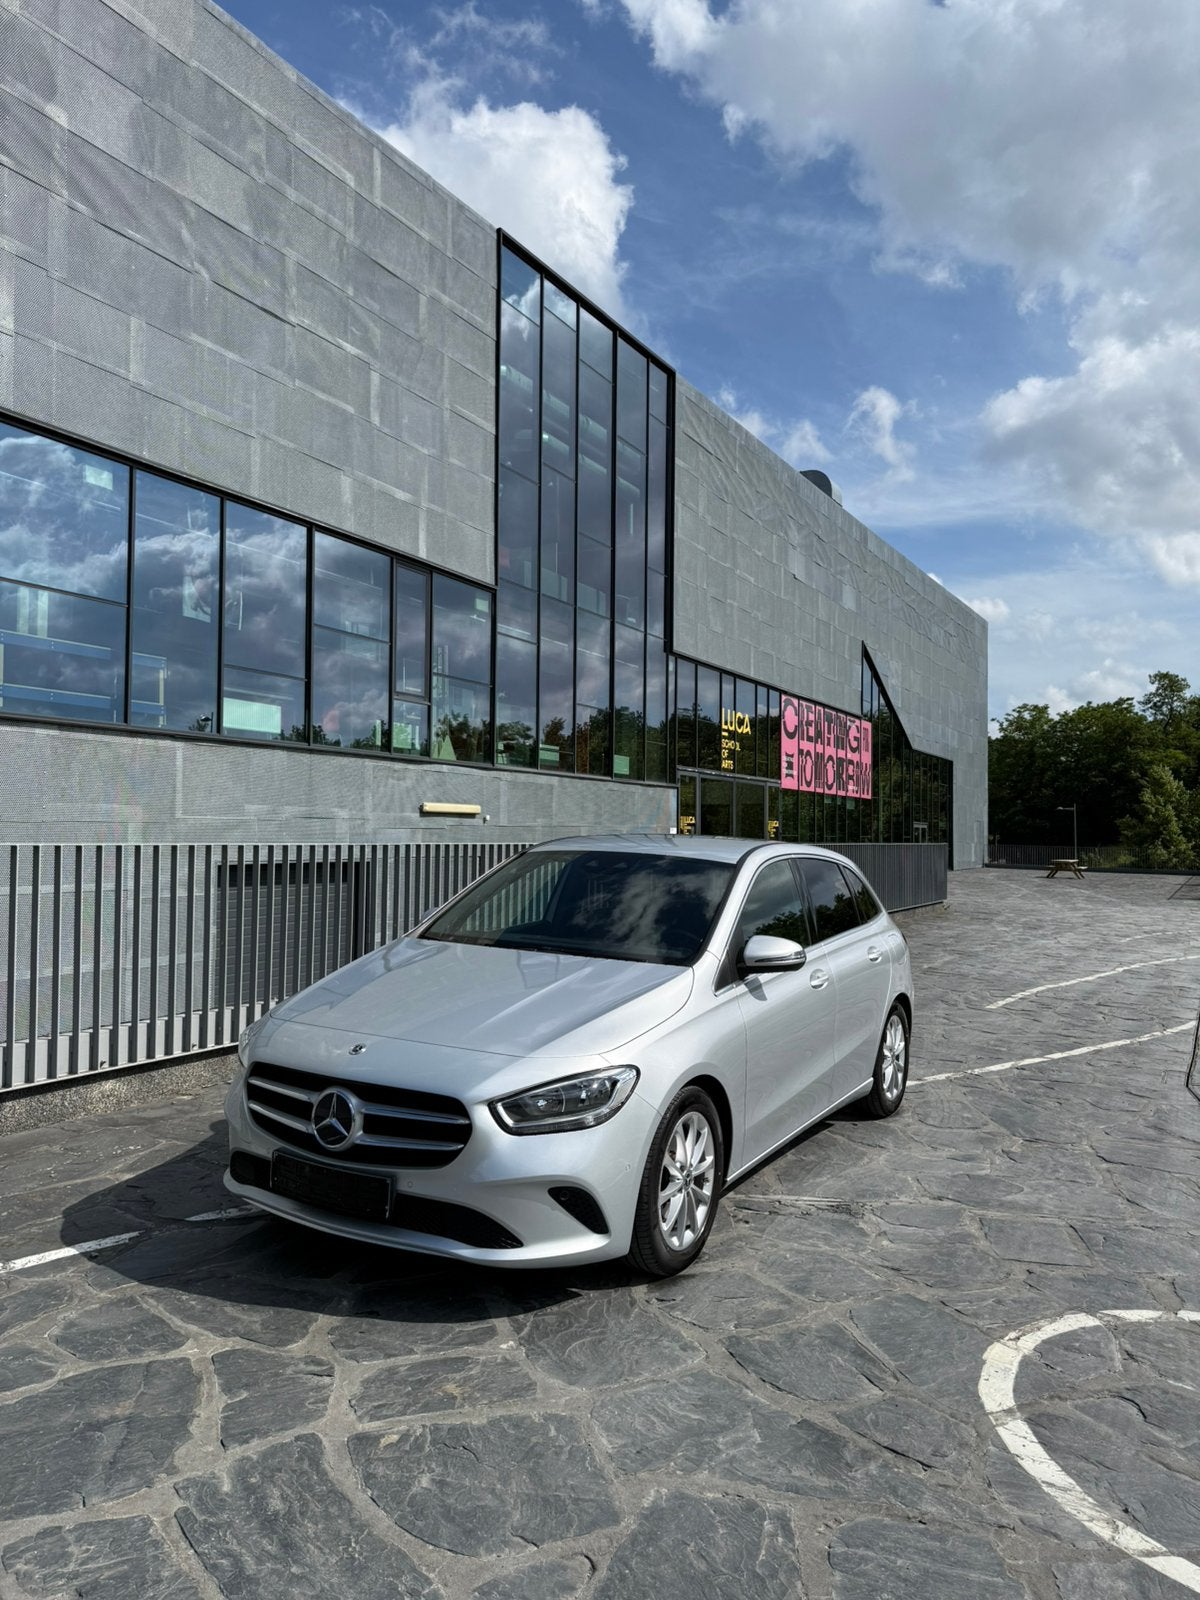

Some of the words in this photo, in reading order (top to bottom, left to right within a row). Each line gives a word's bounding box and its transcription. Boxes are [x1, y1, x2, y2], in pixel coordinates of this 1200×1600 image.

[721, 707, 751, 735] LUCA
[782, 698, 861, 754] CREATING
[721, 749, 729, 758] OF
[721, 759, 734, 770] ARTS
[799, 749, 871, 796] TOMORROW
